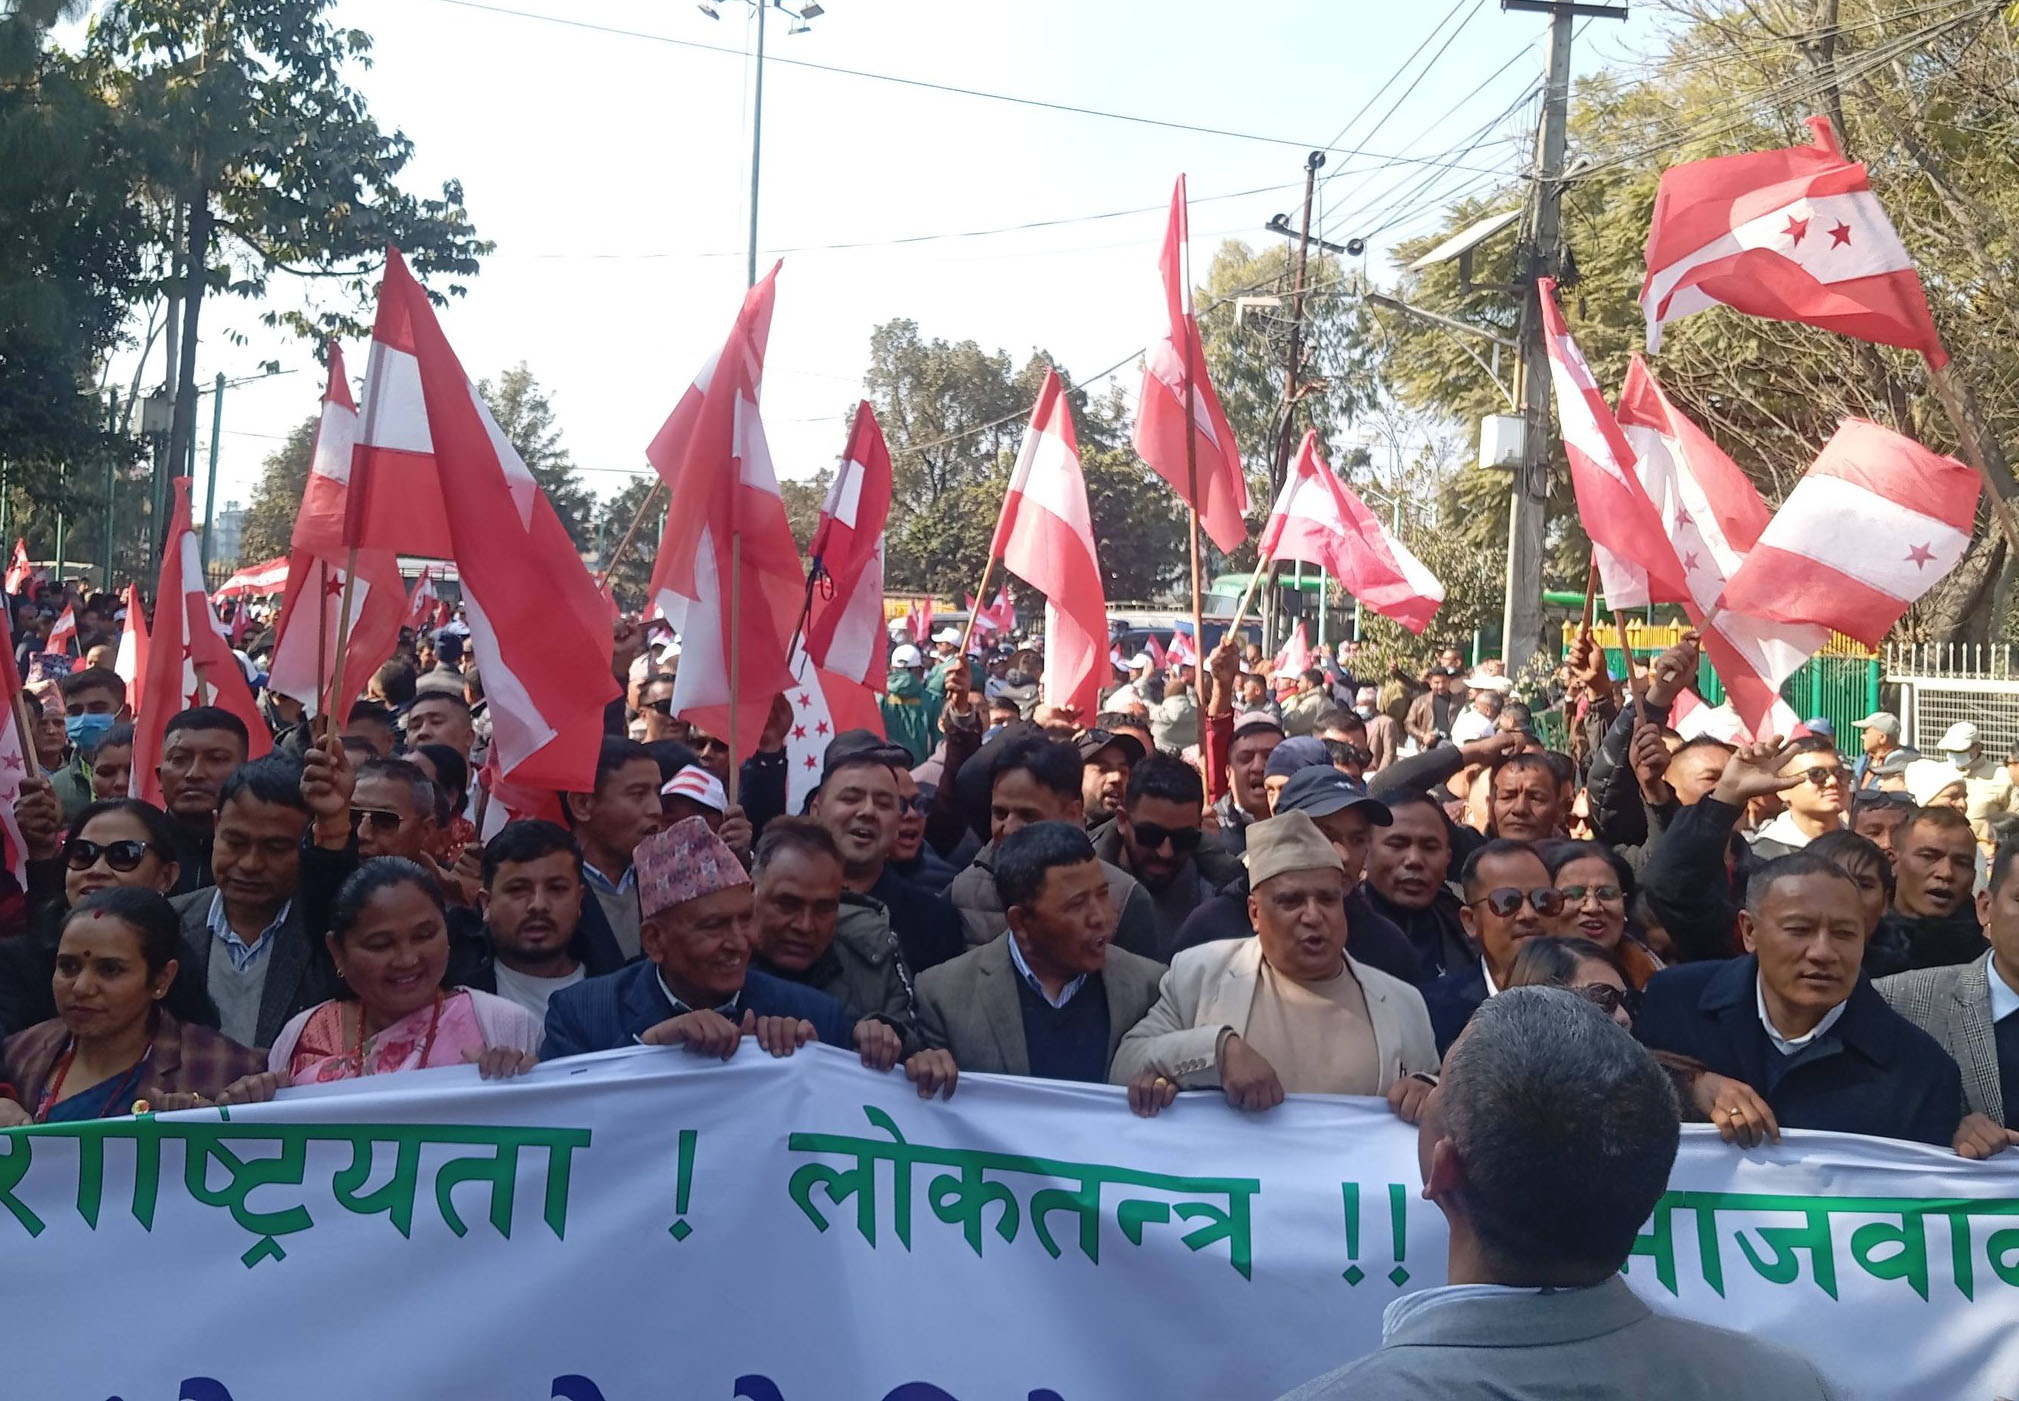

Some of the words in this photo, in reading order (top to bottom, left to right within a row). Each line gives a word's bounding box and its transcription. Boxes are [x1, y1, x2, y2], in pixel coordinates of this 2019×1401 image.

[669, 1129, 698, 1241] !
[788, 1104, 1261, 1282] लोकतन्त्र
[1341, 1181, 1411, 1287] !!
